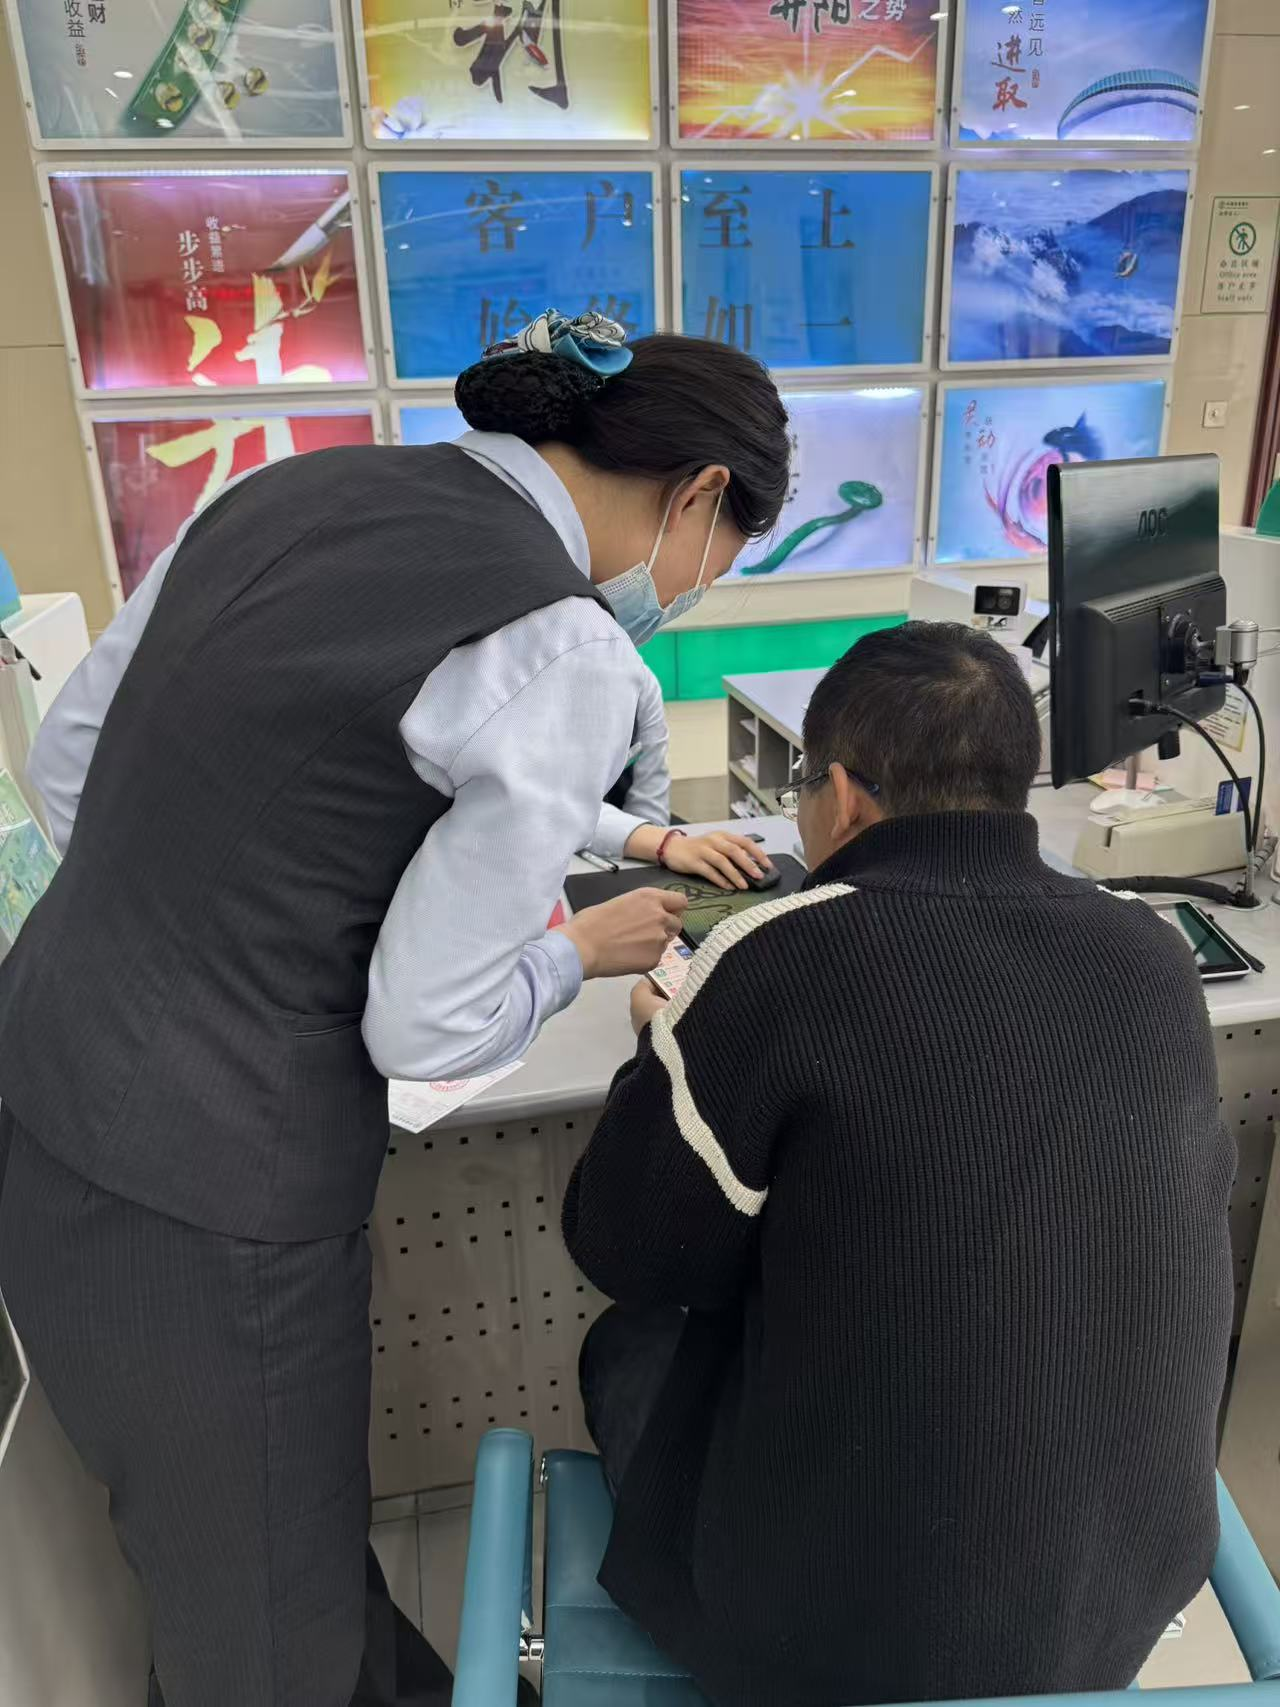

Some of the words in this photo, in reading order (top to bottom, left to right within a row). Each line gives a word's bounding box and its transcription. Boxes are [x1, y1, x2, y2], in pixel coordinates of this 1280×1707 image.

[88, 0, 105, 24] 财
[178, 230, 207, 311] 步步高
